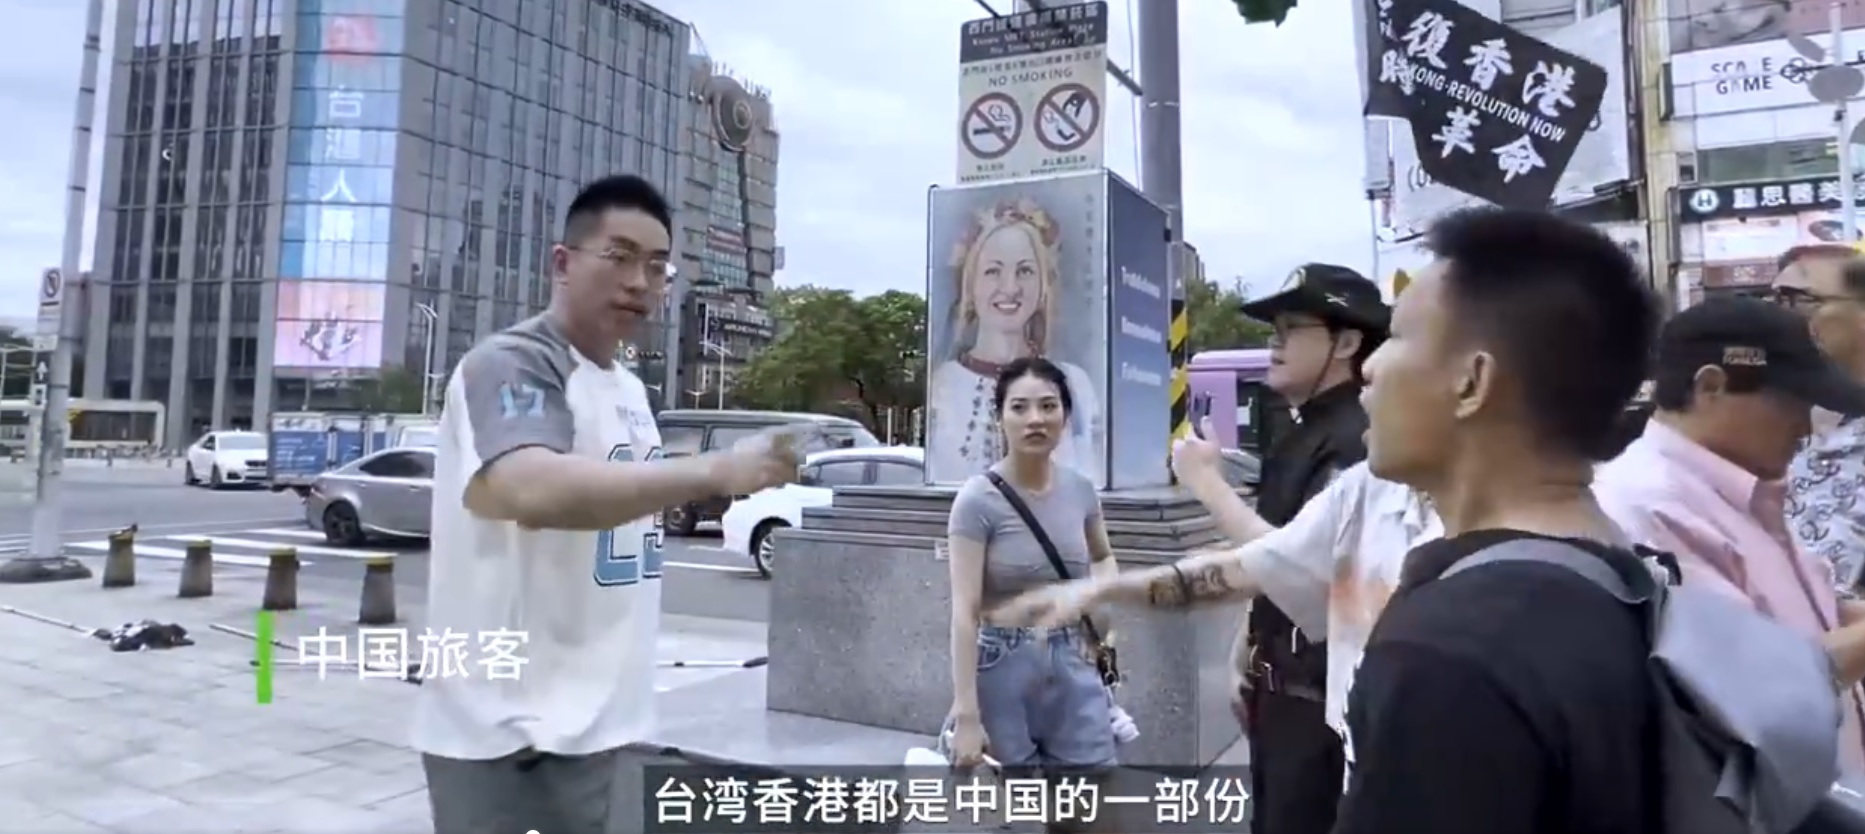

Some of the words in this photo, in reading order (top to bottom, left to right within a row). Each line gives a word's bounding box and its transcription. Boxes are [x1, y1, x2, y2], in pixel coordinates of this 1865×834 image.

[988, 77, 1007, 88] NO
[1011, 68, 1073, 85] SMOKING
[1529, 119, 1567, 144] NOW
